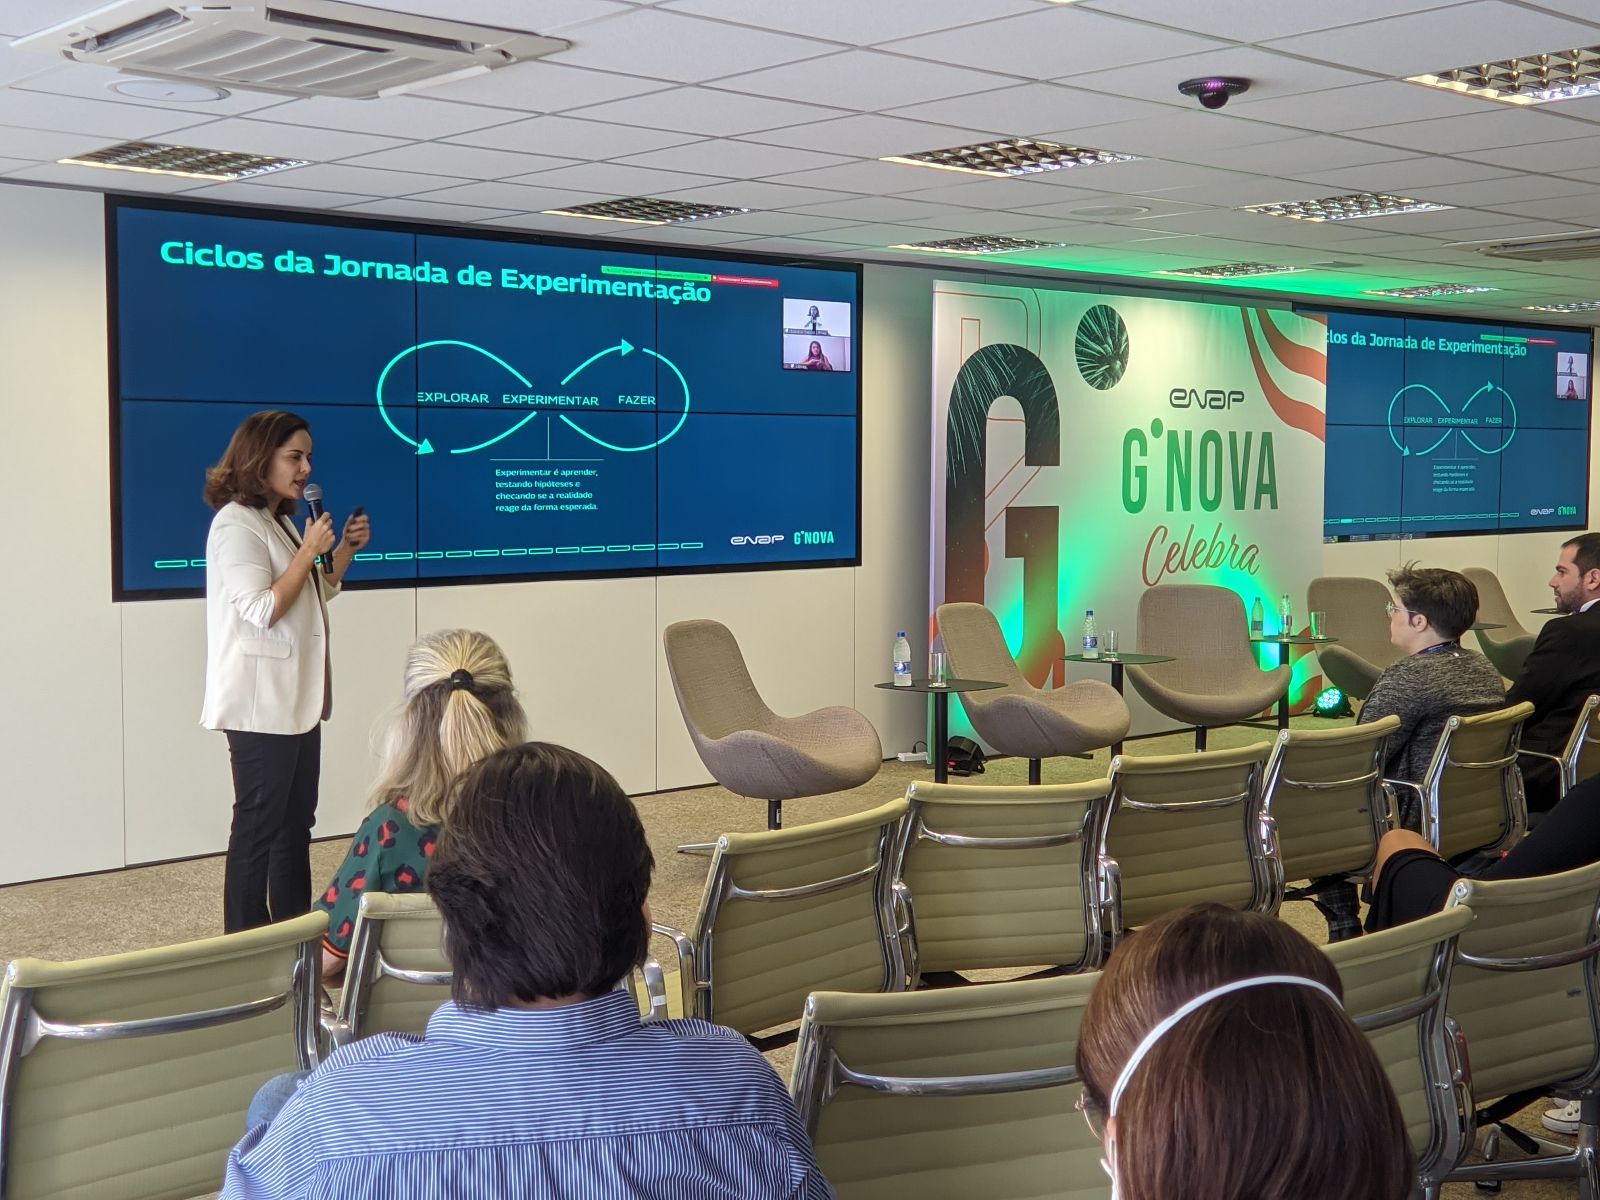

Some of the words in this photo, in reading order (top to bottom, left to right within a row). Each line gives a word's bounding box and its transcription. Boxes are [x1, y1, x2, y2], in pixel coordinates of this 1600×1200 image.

[160, 241, 264, 270] Ciclos
[274, 250, 315, 274] da
[324, 254, 449, 284] Jornada
[457, 265, 492, 286] de
[501, 268, 711, 304] Experimentação
[1351, 331, 1367, 346] da
[1369, 333, 1418, 349] Jornada
[1421, 337, 1436, 350] de
[1438, 338, 1527, 358] Experimentação
[417, 392, 490, 403] EXPLORAR
[502, 394, 599, 406] EXPERIMENTAR
[618, 395, 656, 405] FAZER
[495, 469, 552, 478] Experimentar
[495, 481, 533, 489] testando
[495, 492, 536, 500] checando
[555, 491, 593, 499] realidade
[495, 504, 520, 513] reage
[533, 503, 559, 511] forma
[1142, 522, 1260, 587] Celebra
